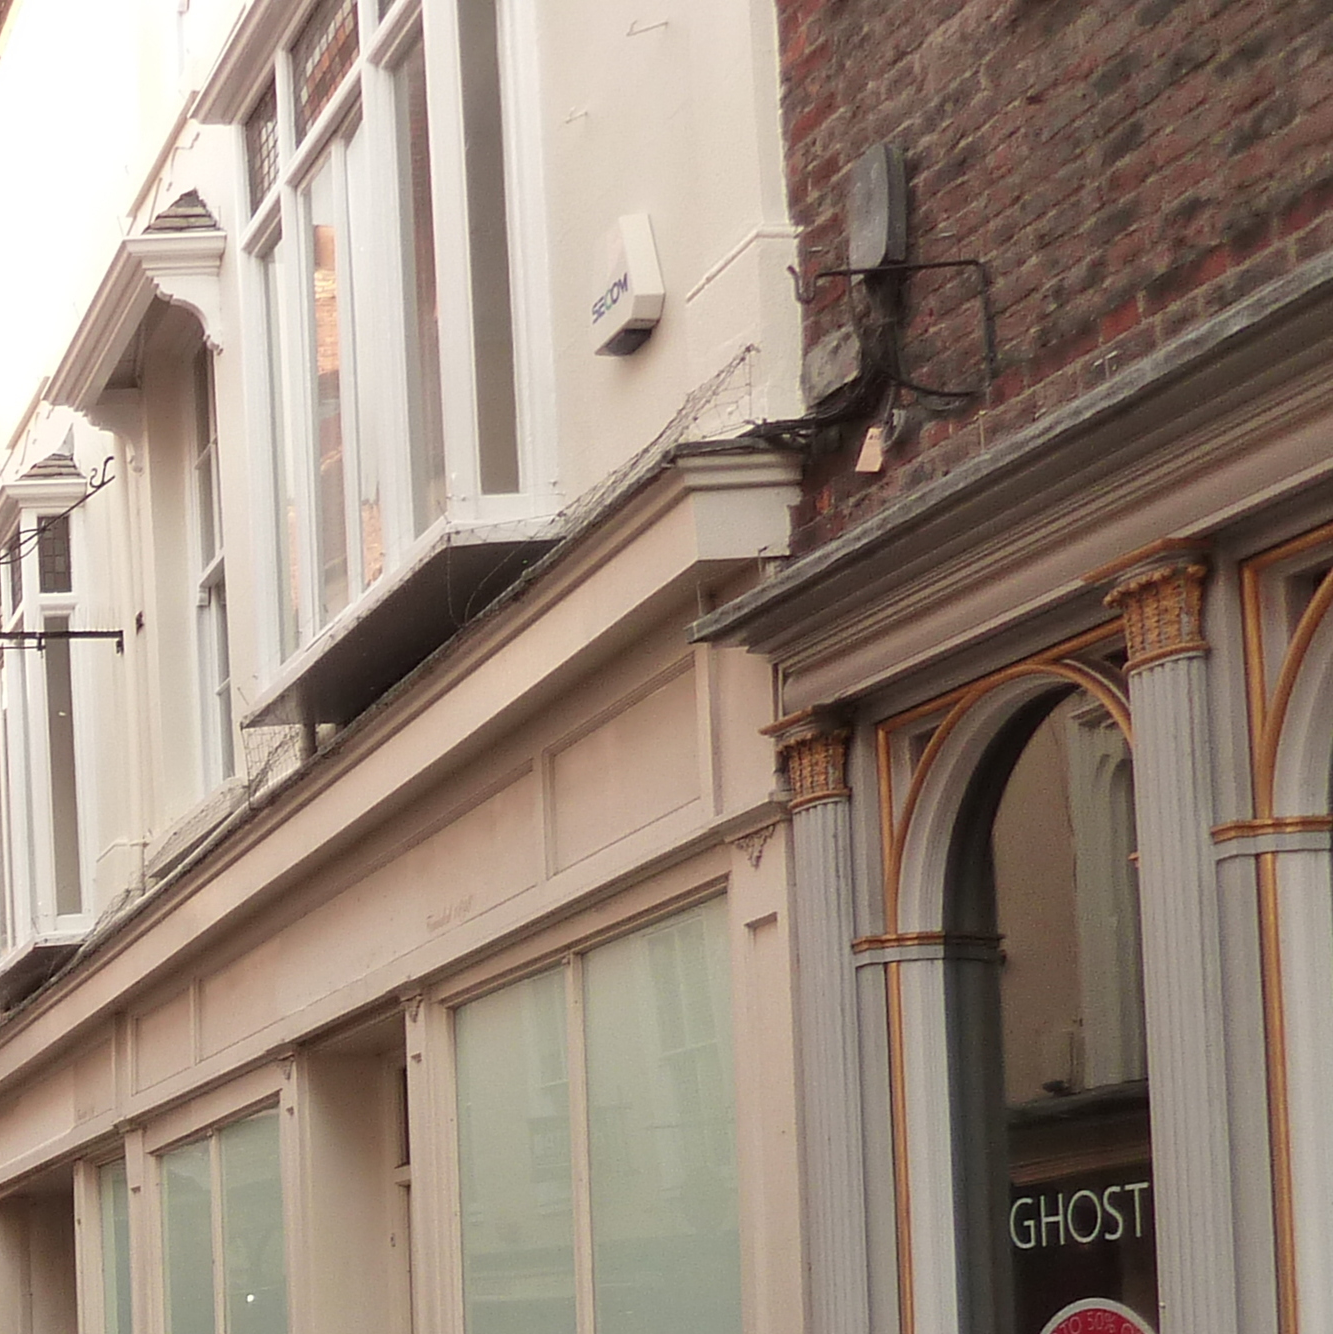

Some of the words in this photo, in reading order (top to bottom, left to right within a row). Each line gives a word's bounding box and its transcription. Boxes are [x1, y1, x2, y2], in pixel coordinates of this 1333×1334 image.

[592, 272, 628, 325] SECOM
[1008, 1180, 1151, 1251] GHOST
[1087, 1311, 1117, 1334] 50%
